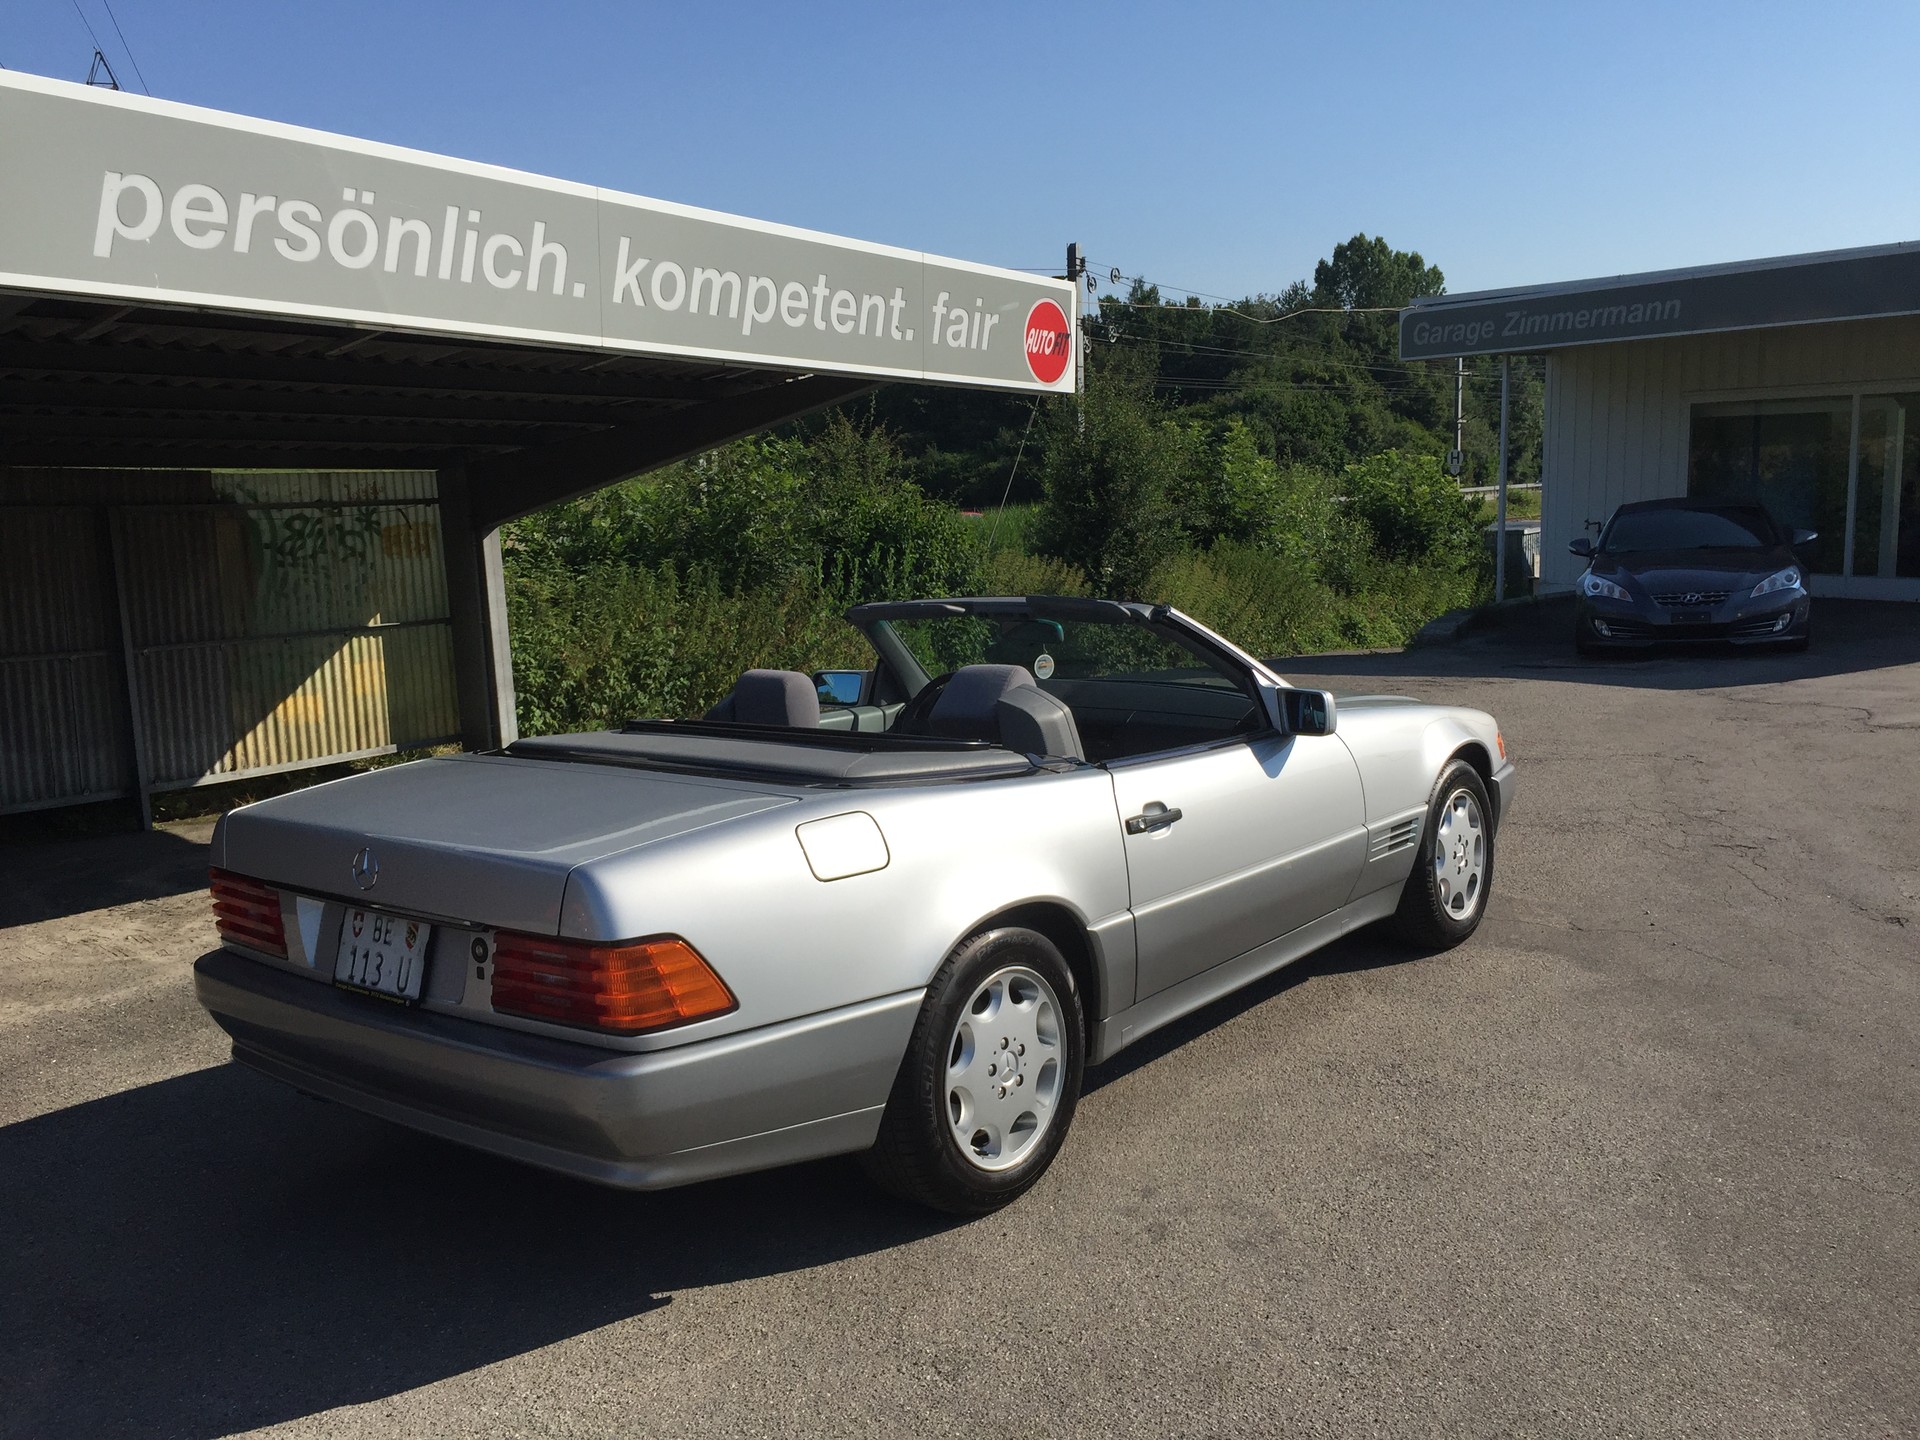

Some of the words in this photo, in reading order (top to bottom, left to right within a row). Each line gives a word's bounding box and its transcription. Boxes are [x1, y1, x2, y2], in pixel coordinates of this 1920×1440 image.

[93, 170, 586, 298] persönlich.
[612, 236, 915, 341] kompetent.
[932, 291, 1000, 351] fair
[1412, 319, 1495, 347] Garage
[1501, 298, 1682, 337] Zimmermann
[1025, 328, 1071, 356] AUTOFIT
[1450, 451, 1460, 465] H
[372, 917, 395, 946] BE
[347, 945, 384, 987] 113
[396, 956, 413, 993] U
